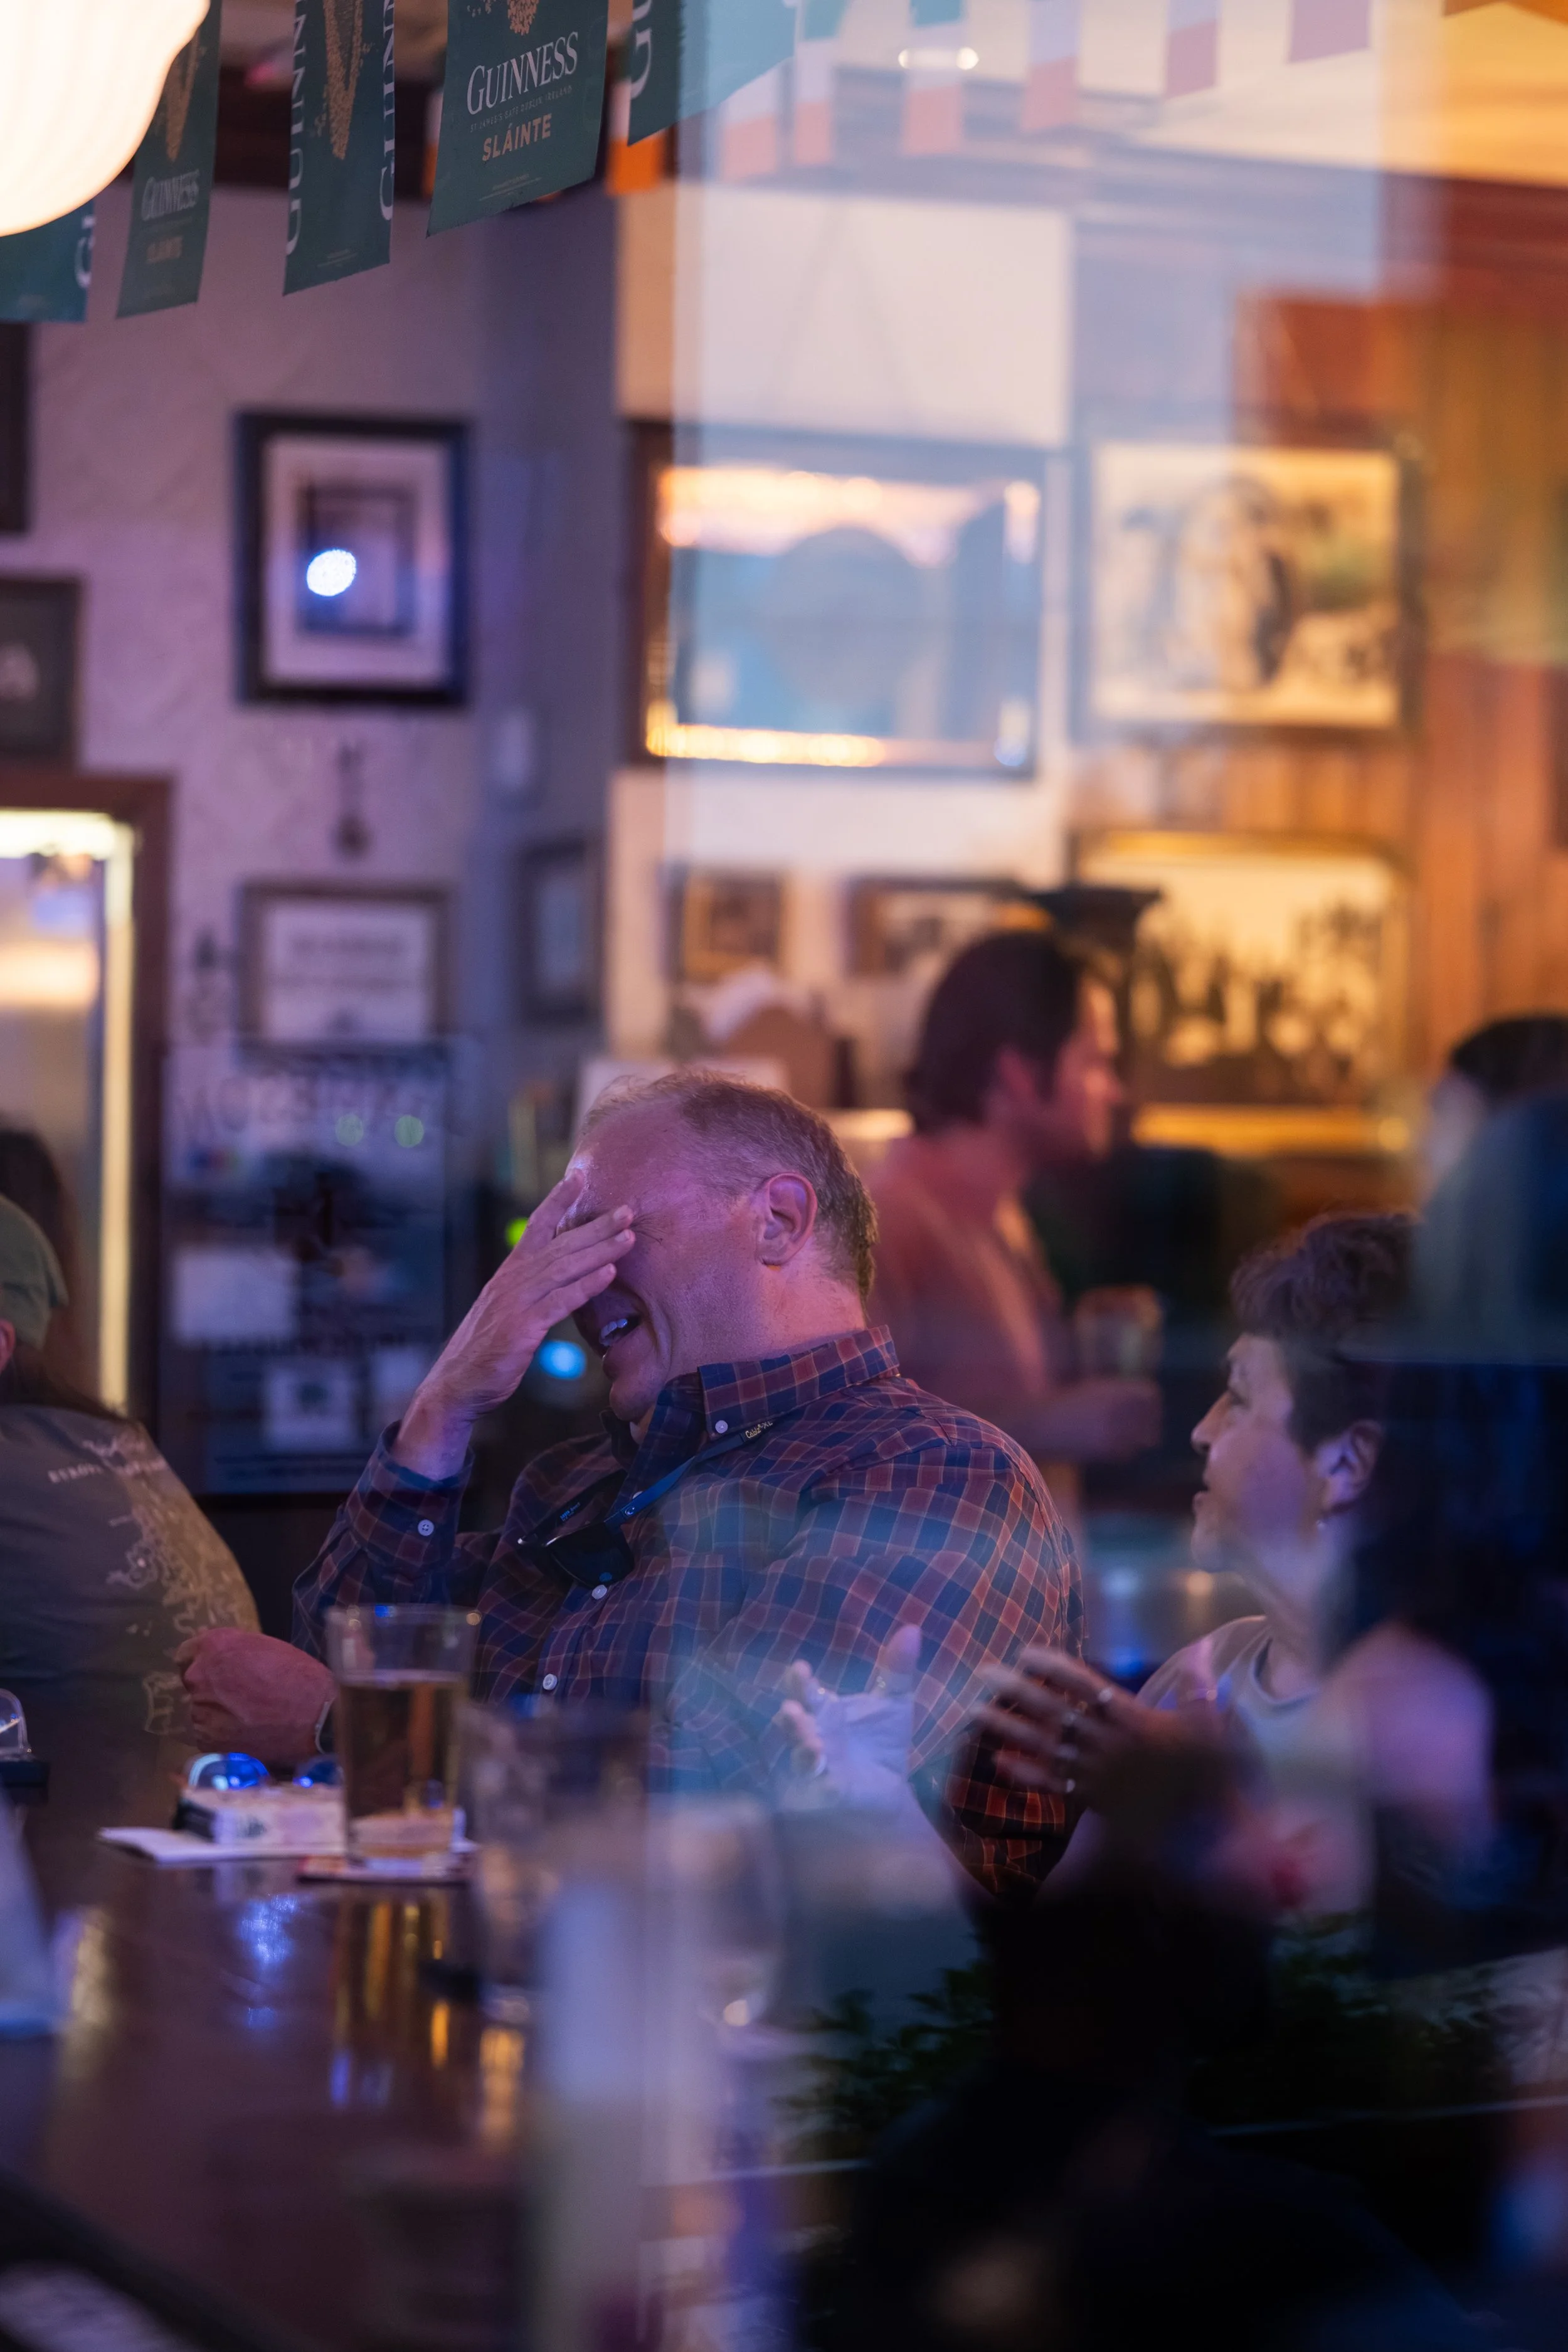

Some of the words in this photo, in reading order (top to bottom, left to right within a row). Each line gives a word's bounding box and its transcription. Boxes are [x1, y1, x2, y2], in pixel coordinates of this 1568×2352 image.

[467, 31, 578, 115] GUINNESS
[544, 85, 573, 101] IRELAND
[482, 114, 553, 162] SLÁINTE
